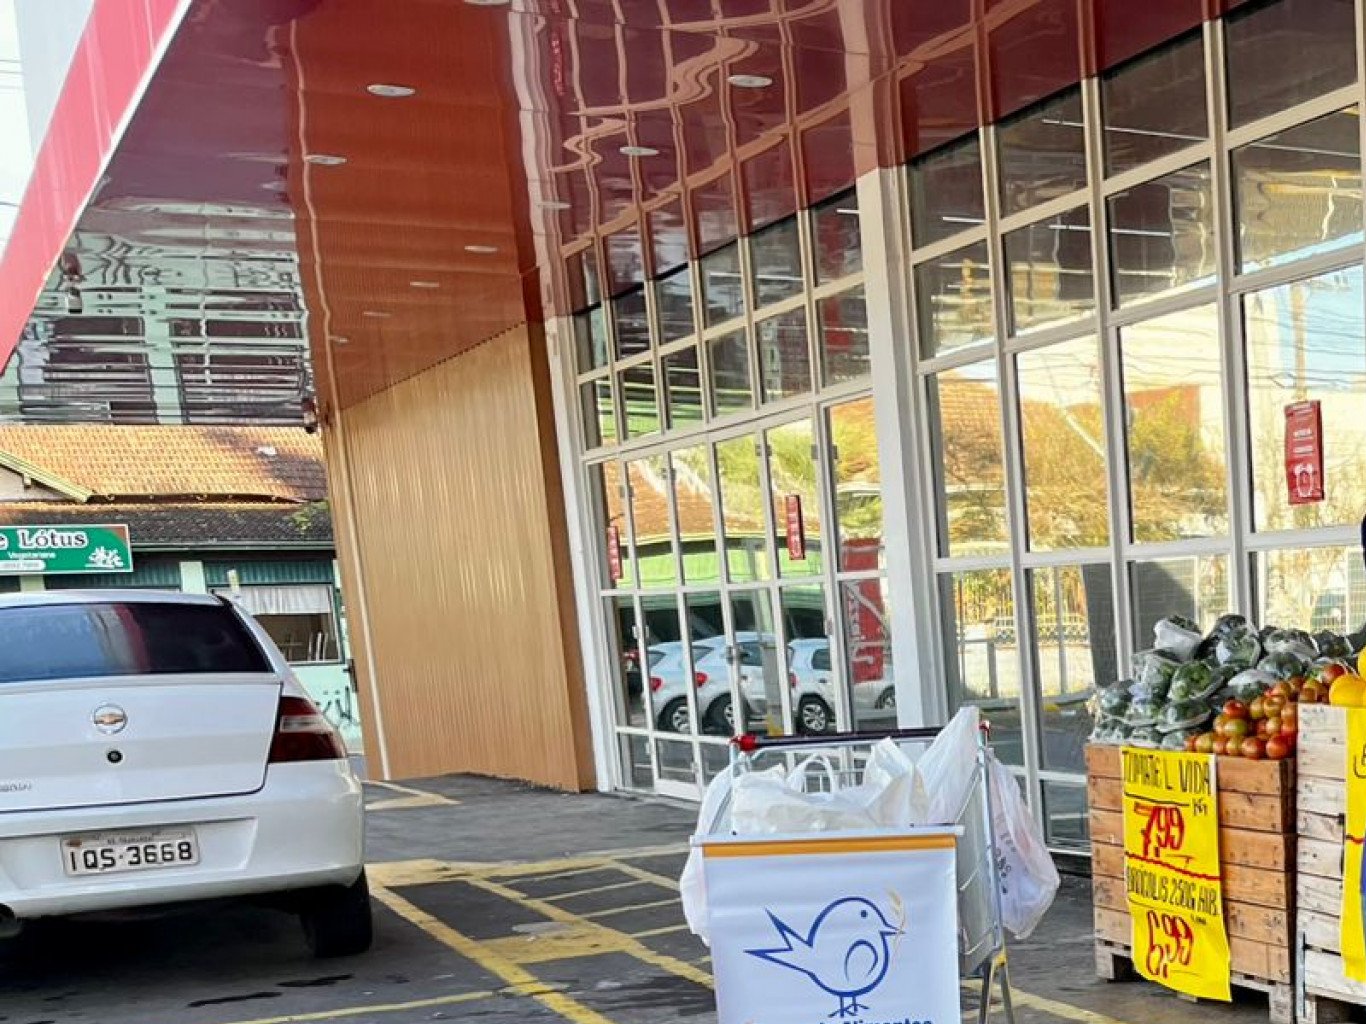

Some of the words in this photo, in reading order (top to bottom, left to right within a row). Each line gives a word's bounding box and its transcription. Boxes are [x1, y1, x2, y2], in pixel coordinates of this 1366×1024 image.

[17, 529, 89, 549] Lótus
[1134, 801, 1185, 861] 7,99
[1146, 909, 1194, 979] 6,99
